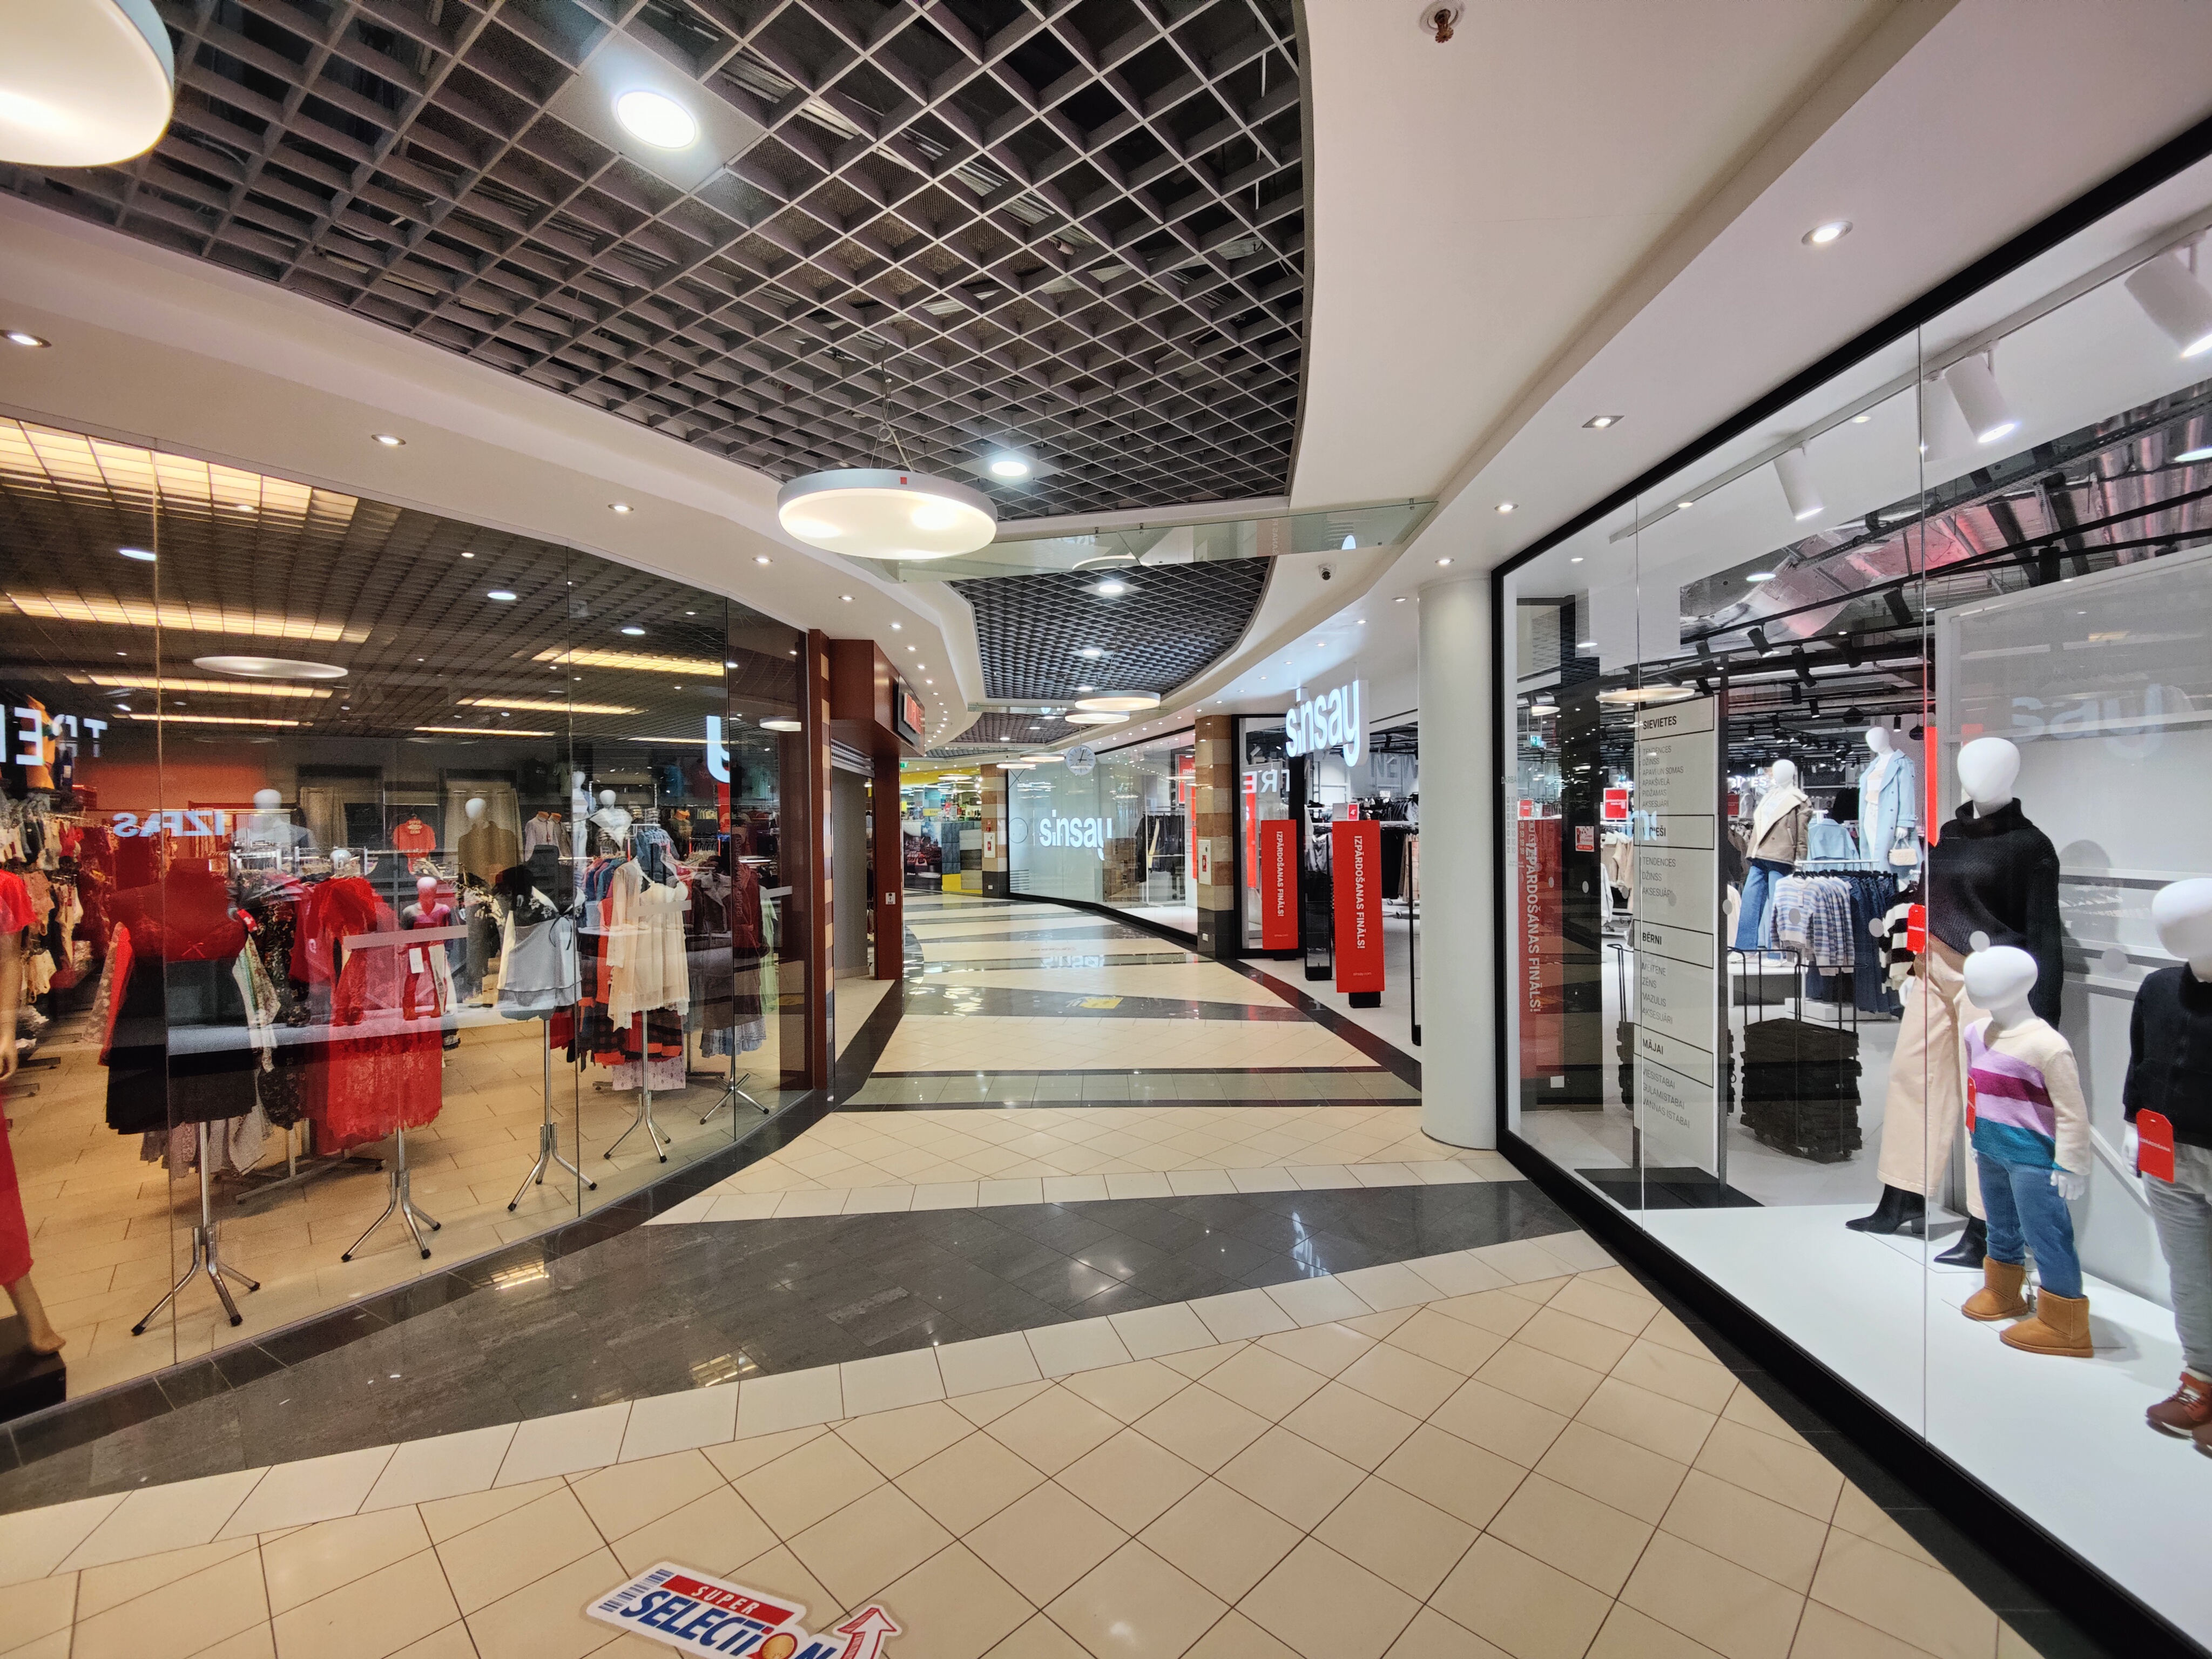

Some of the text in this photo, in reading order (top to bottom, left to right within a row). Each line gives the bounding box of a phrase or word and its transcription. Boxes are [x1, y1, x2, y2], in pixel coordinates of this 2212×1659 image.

[1285, 680, 1361, 767] sinsay
[1643, 716, 1677, 730] SIEVIETES
[1665, 766, 1684, 774] SOMAS
[1642, 788, 1667, 797] PIDŽAMAS
[1039, 809, 1112, 861] sinsay
[1276, 831, 1284, 887] IZPĀRDOŠANAS
[1643, 857, 1676, 867] TENDENCES
[1642, 871, 1662, 881] DŽINSS
[1354, 835, 1366, 949] IZPĀRDOŠANAS FINĀLS!
[1642, 932, 1662, 945] BĒRNI
[1642, 962, 1667, 976] MEITENE
[1528, 956, 1543, 1013] FINĀLS!
[1642, 976, 1657, 988] ZĒNS
[1642, 992, 1667, 1007] MAZULIS
[1642, 1007, 1673, 1024] AKSESUĀRI
[1643, 1038, 1663, 1055] MĀJAI
[1643, 1068, 1675, 1089] VIESISTABAI
[1643, 1098, 1690, 1129] VANNAS ISTABAI
[691, 1585, 761, 1615] SUPER
